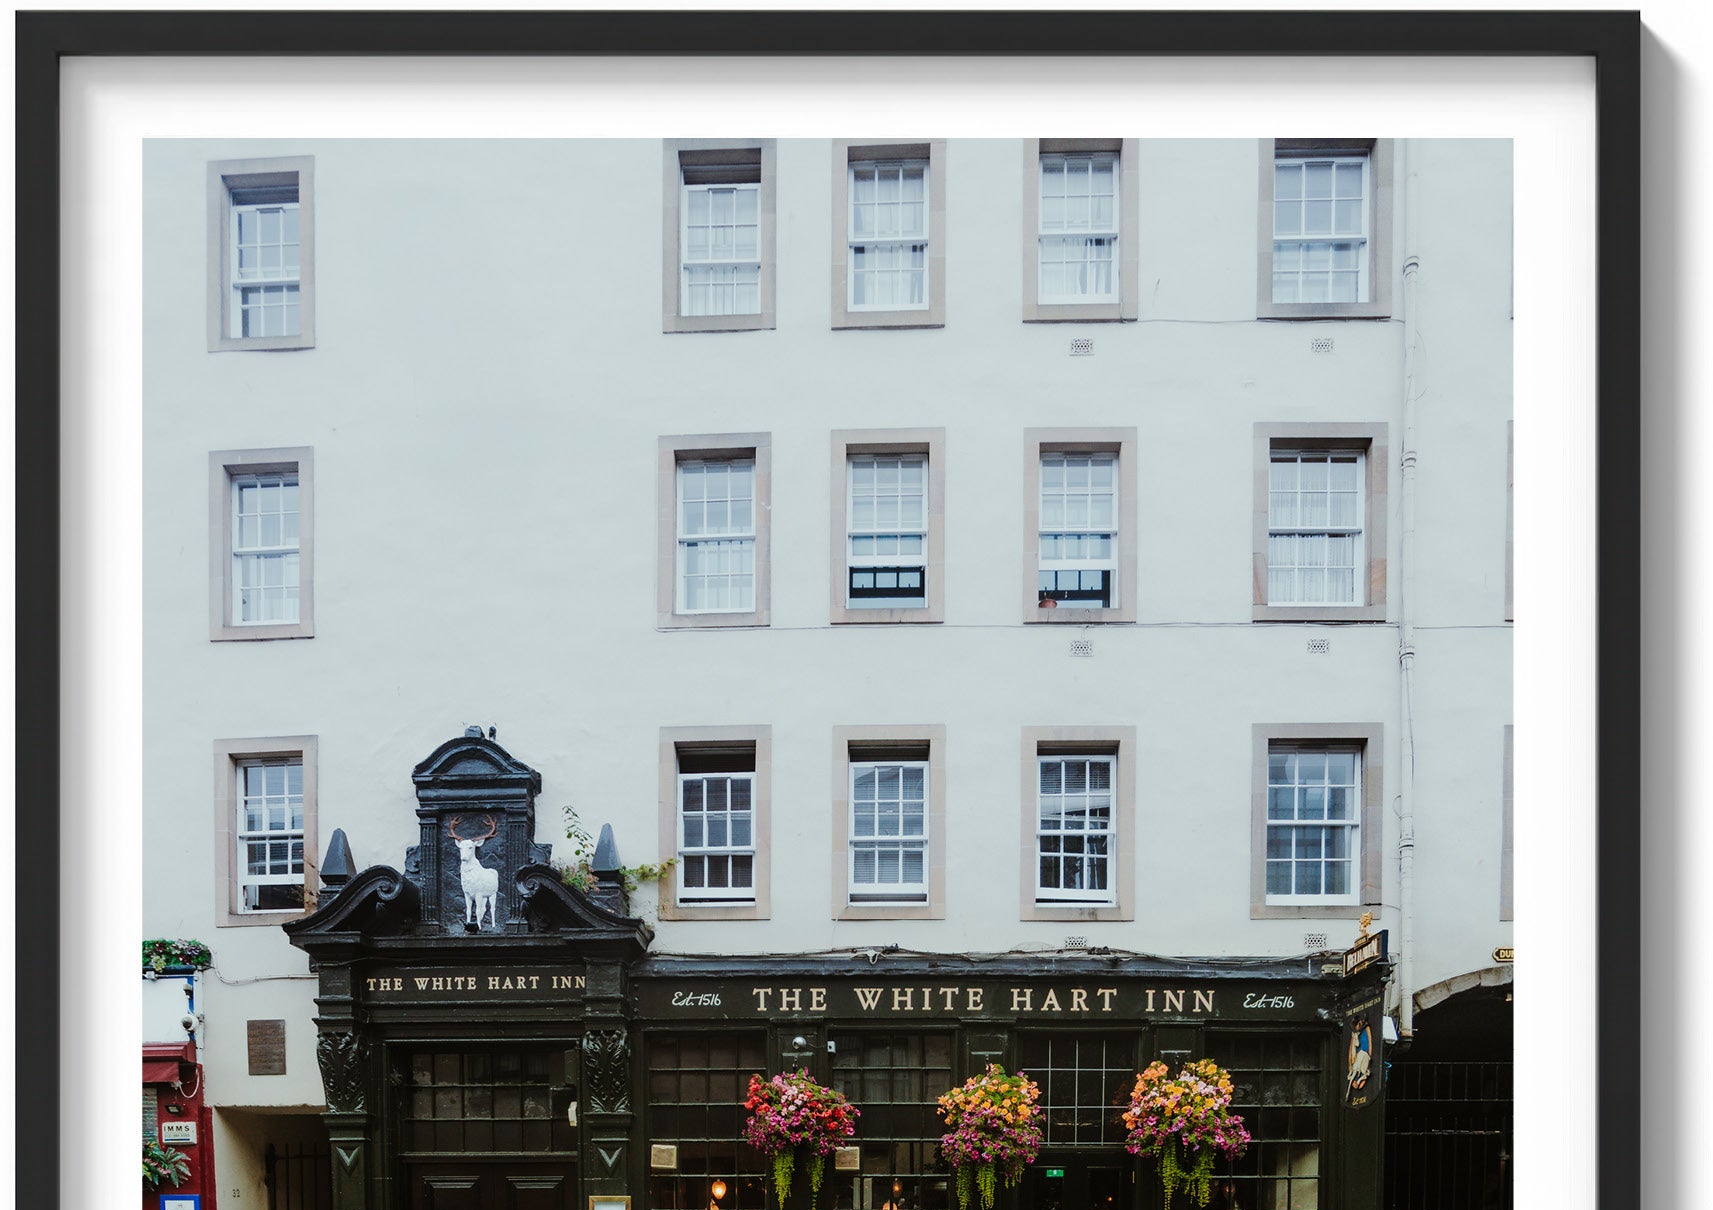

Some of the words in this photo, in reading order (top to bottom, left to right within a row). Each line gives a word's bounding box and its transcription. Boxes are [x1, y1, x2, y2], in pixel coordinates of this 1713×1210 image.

[366, 977, 403, 991] THE
[414, 976, 477, 991] WHITE
[487, 976, 540, 990] HART
[552, 975, 586, 989] INN
[752, 987, 828, 1012] THE
[853, 987, 984, 1011] WHITE
[1010, 987, 1118, 1012] HART
[1145, 989, 1215, 1013] INN
